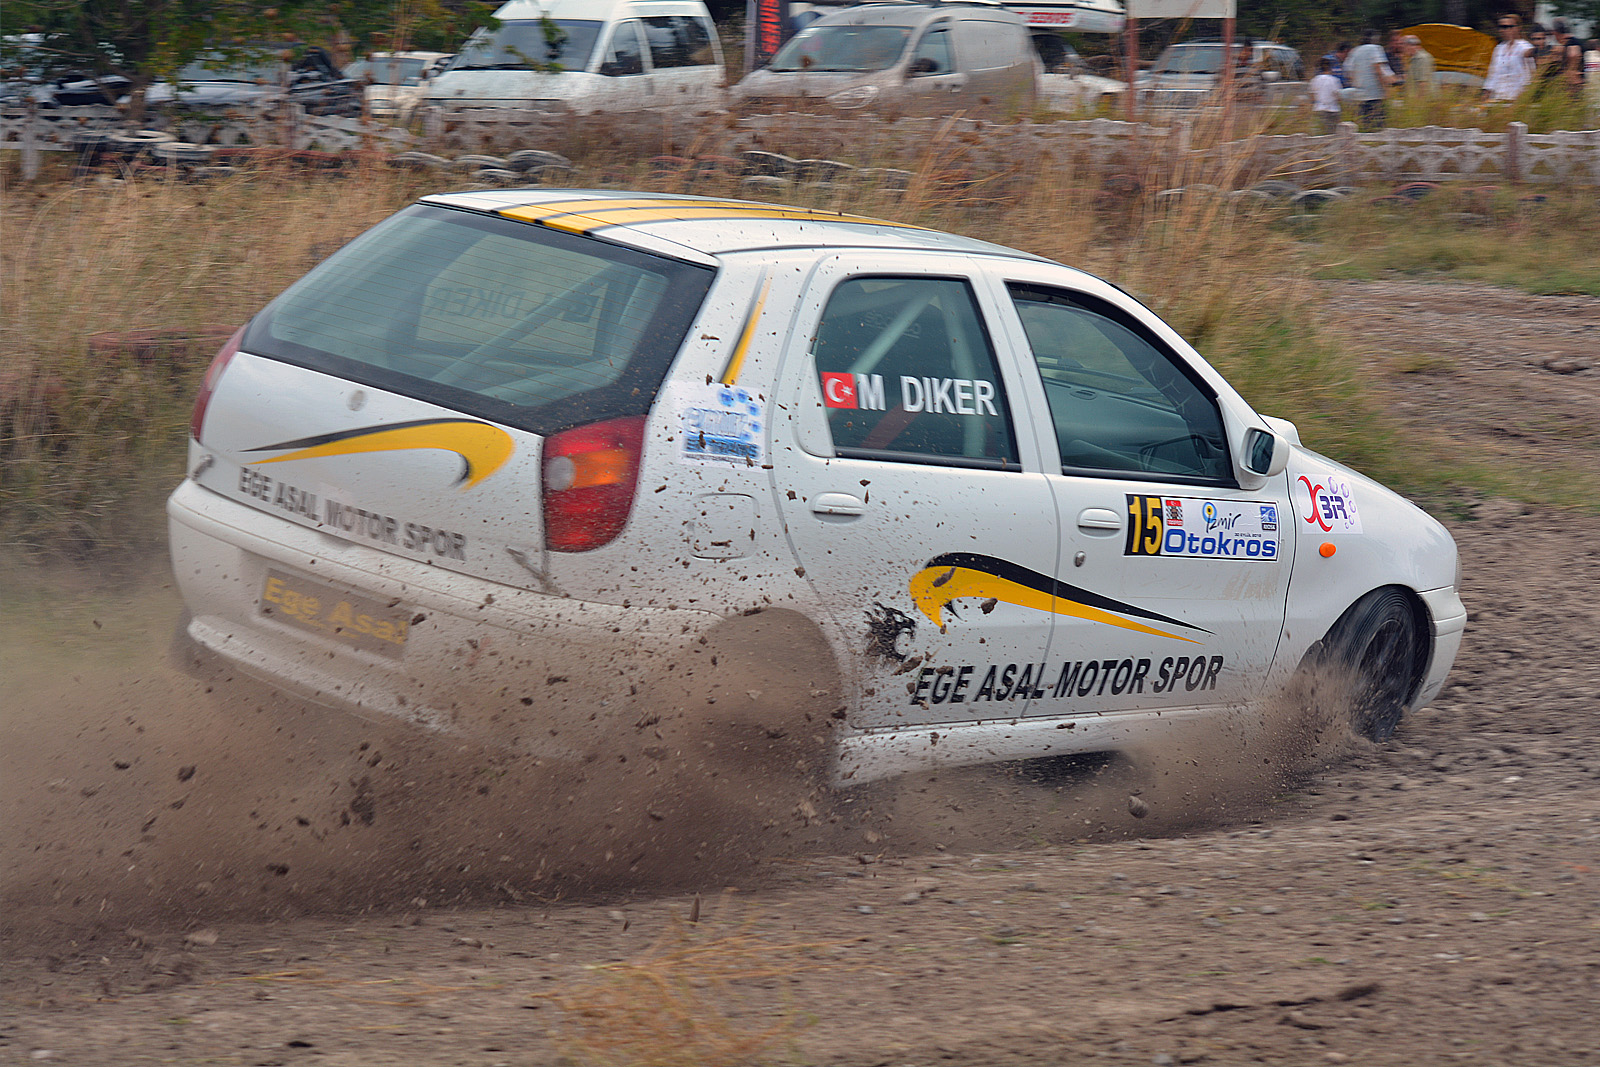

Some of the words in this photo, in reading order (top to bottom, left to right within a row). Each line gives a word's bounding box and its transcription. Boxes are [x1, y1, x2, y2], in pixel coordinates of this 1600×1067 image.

[856, 373, 886, 411] M
[900, 375, 998, 416] DIKER
[238, 466, 272, 502] EGE
[273, 482, 321, 521] ASAL
[326, 499, 398, 545] MOTOR
[403, 522, 467, 561] SPOR
[1128, 496, 1163, 555] 15
[1164, 528, 1276, 557] Otokros
[263, 577, 320, 616] Ege
[910, 665, 974, 705] EGE
[974, 662, 1047, 702] ASAL
[1053, 658, 1151, 699] MOTOR
[1153, 655, 1224, 693] SPOR
